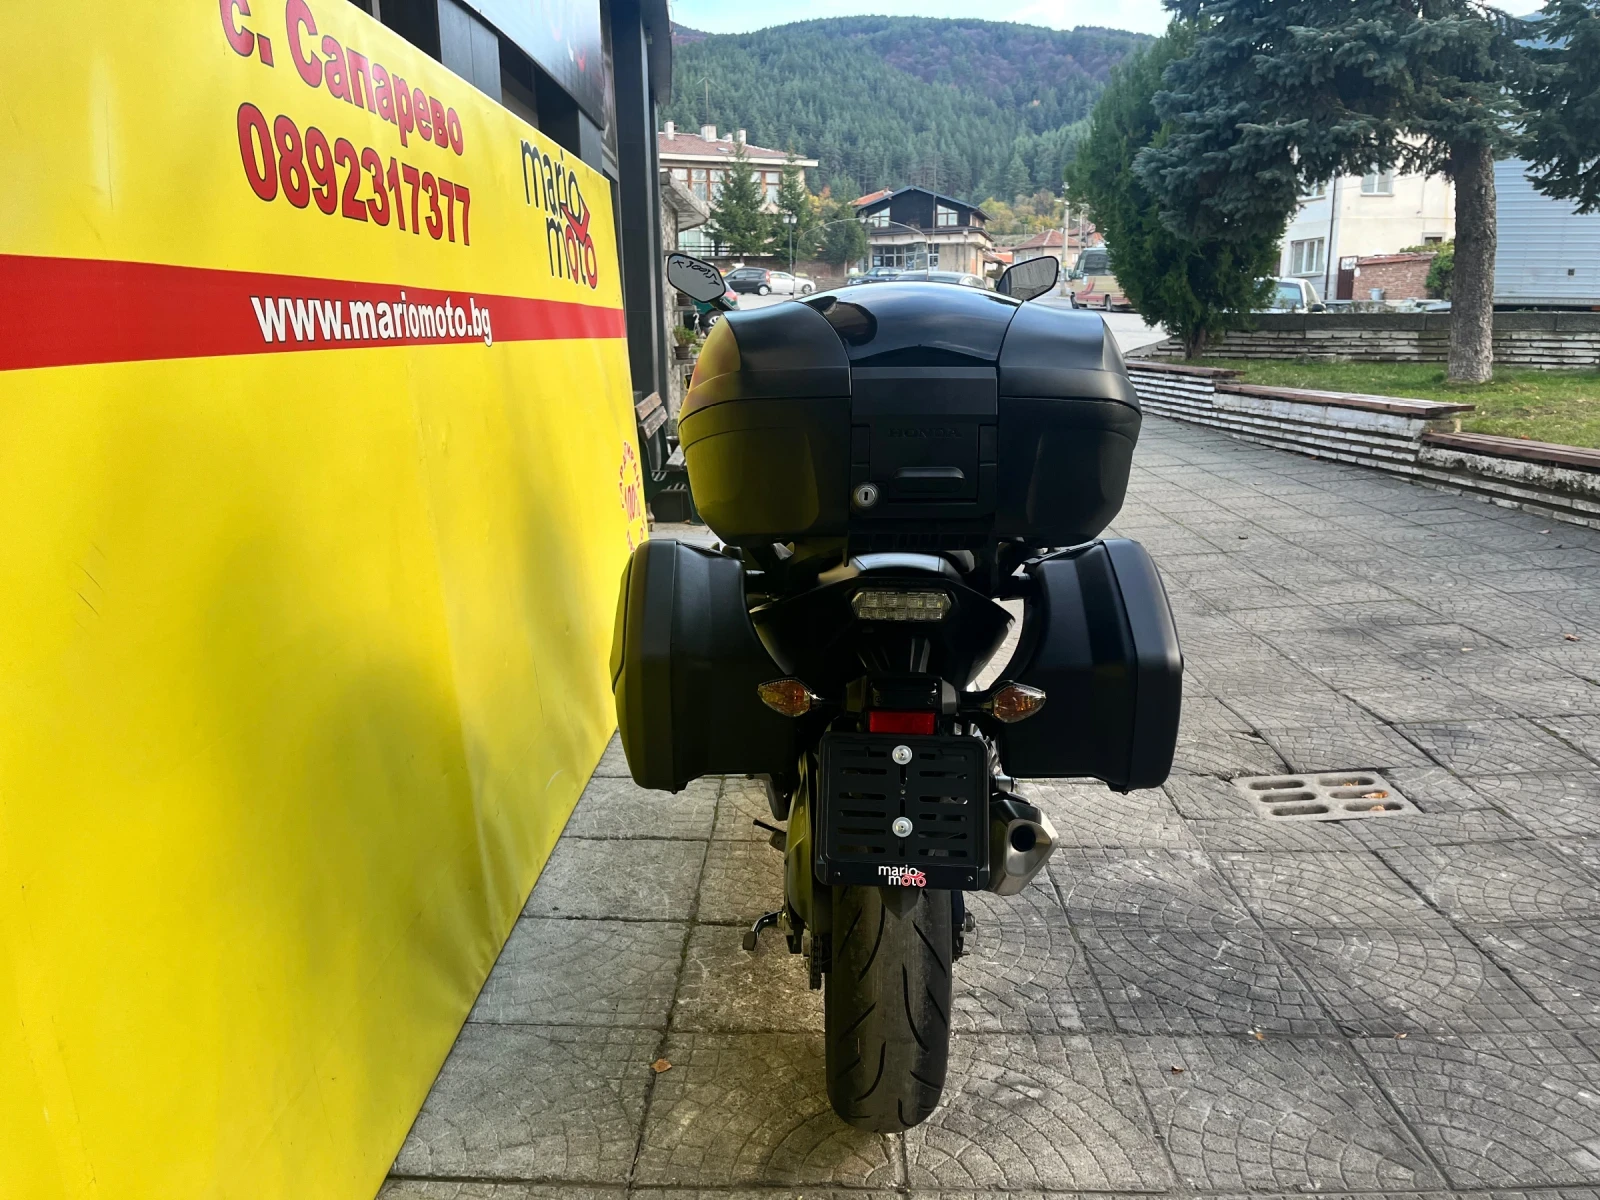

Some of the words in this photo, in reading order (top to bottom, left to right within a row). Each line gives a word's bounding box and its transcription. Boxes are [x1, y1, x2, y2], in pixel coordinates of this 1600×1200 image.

[285, 0, 464, 156] Сапарево
[237, 102, 470, 246] 0892317377
[520, 140, 581, 225] mario
[546, 217, 598, 289] moto
[250, 291, 493, 347] www.mariomoto.bg
[878, 864, 919, 877] mario
[888, 874, 927, 887] moto
